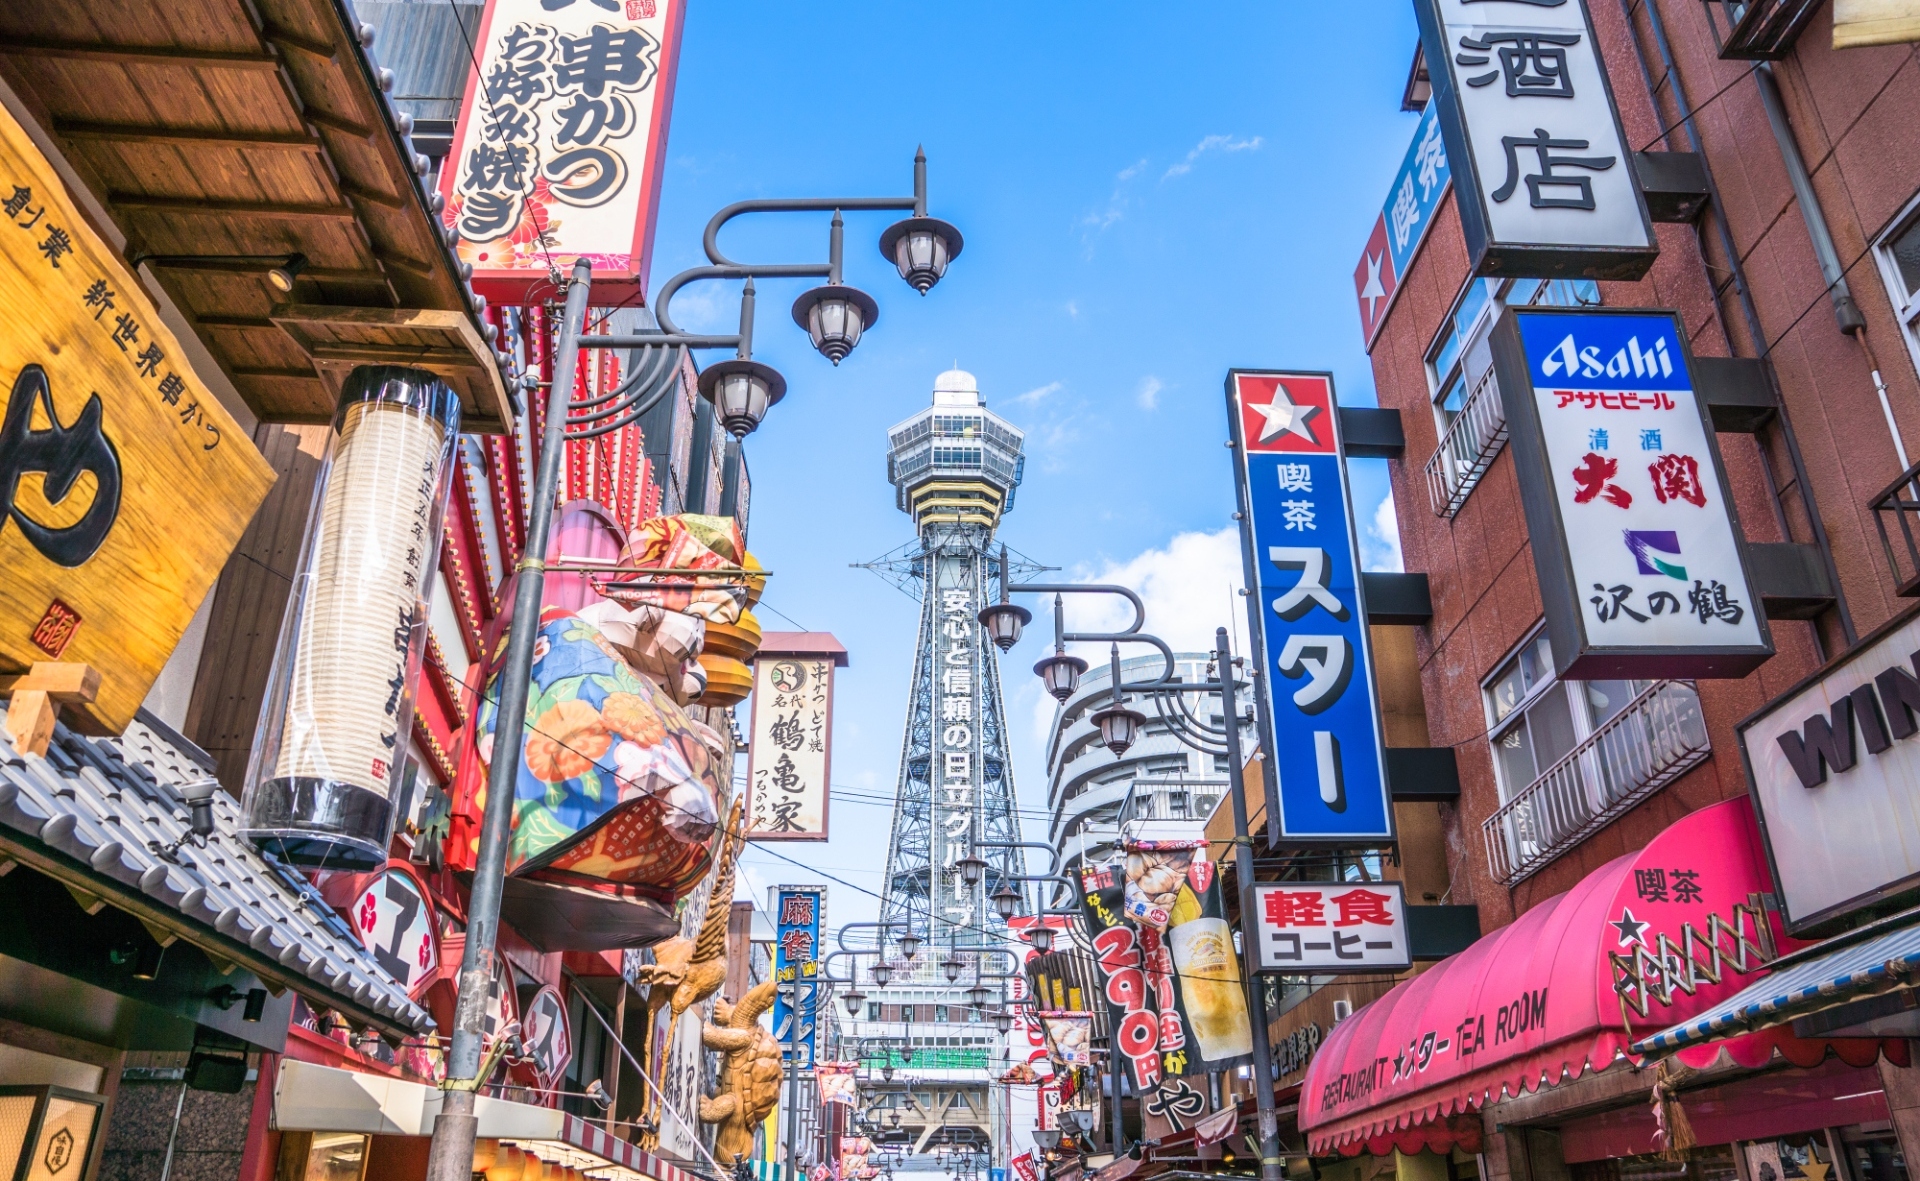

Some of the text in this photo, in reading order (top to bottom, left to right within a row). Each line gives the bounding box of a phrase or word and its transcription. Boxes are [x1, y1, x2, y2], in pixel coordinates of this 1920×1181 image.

[458, 22, 557, 243] お好み焼き
[542, 23, 660, 208] 串かつ
[1456, 0, 1616, 210] 酒店
[82, 279, 221, 450] 新世界串かつ
[1541, 333, 1675, 379] Asahi
[1552, 390, 1676, 411] アサヒビール
[1276, 462, 1318, 532] 喫茶
[1572, 452, 1708, 509] 大関
[1589, 579, 1745, 626] 沢の鶴
[810, 661, 829, 704] 串かつ
[1267, 545, 1352, 814] スター
[769, 709, 807, 832] 鶴亀家
[1263, 889, 1394, 928] 軽食
[1634, 868, 1704, 904] 喫茶
[779, 894, 815, 962] 麻雀
[1271, 930, 1393, 960] コーヒー
[1320, 1056, 1389, 1112] RESTAURANT
[1455, 1014, 1486, 1061] TEA
[1494, 987, 1548, 1045] ROOM
